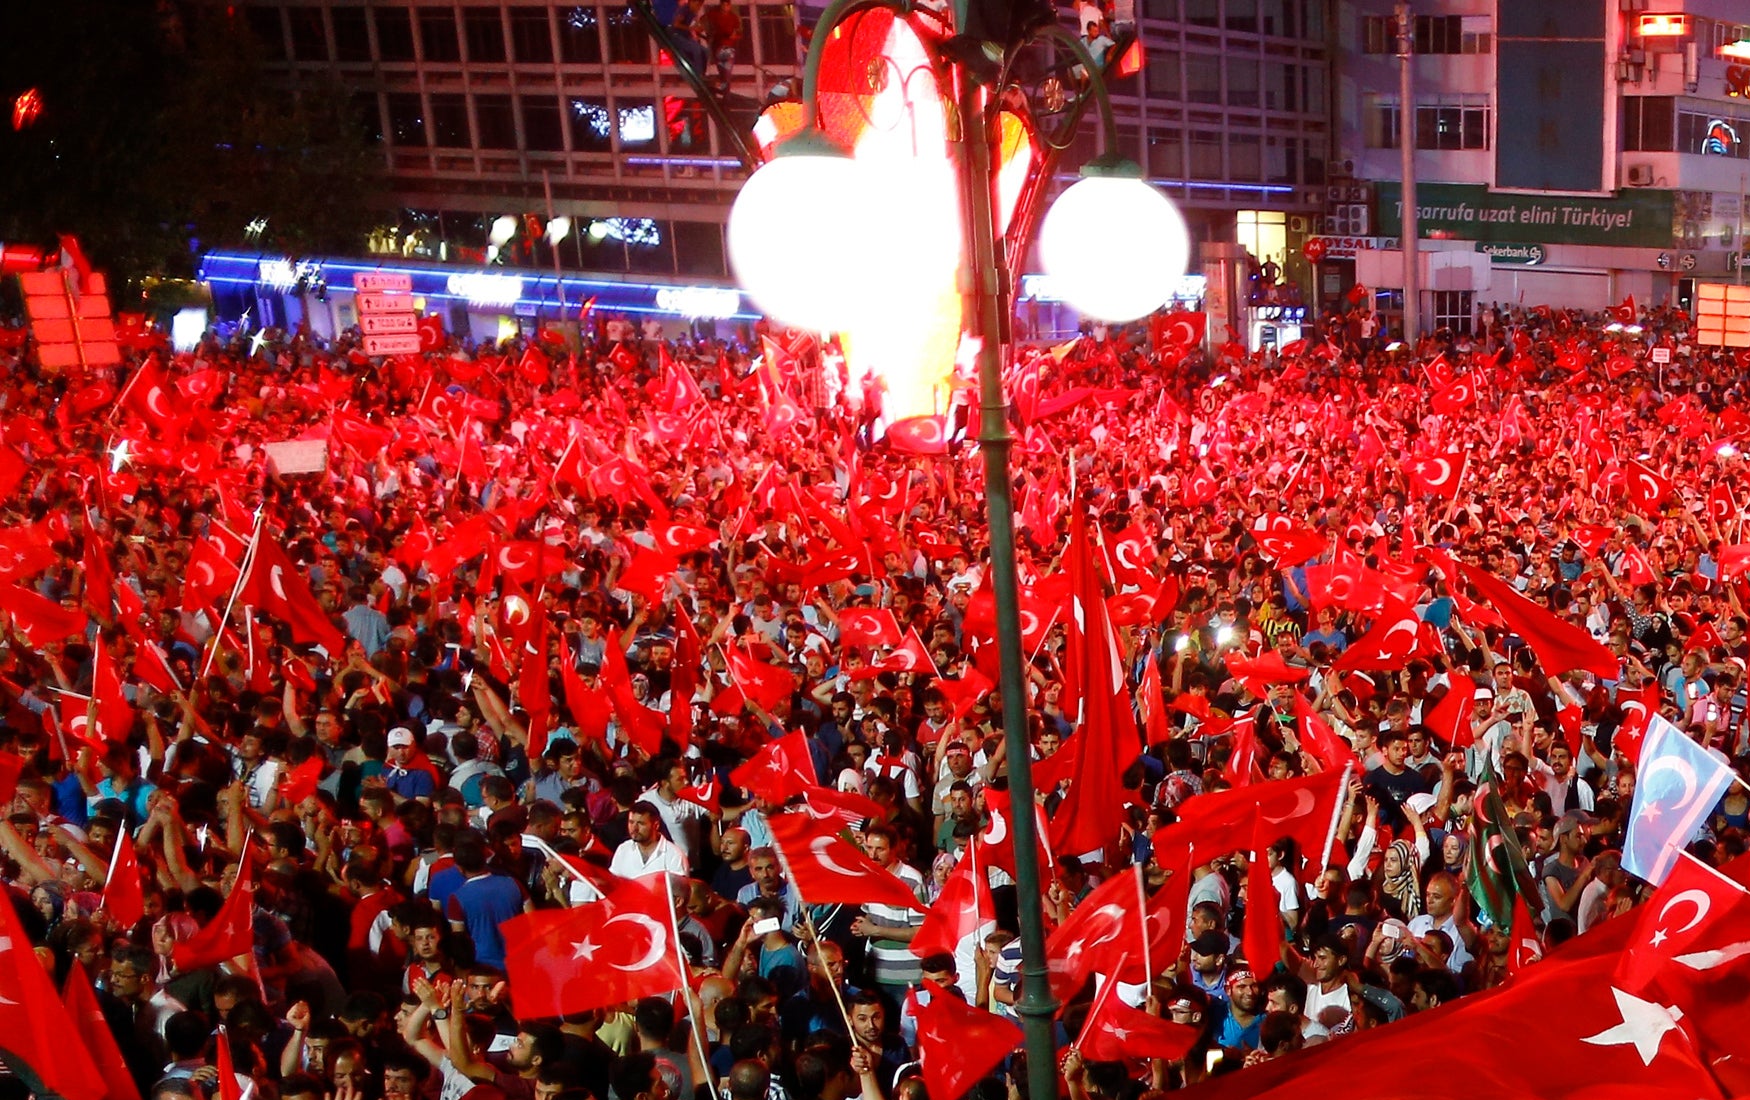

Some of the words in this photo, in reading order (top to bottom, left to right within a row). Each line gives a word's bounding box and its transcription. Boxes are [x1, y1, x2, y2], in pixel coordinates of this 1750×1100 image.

[1395, 201, 1474, 221] Tsarrufa
[1479, 206, 1516, 222] uzat
[1520, 207, 1557, 224] elini
[1562, 207, 1633, 231] Türkiye!
[1323, 237, 1375, 250] OYSAL
